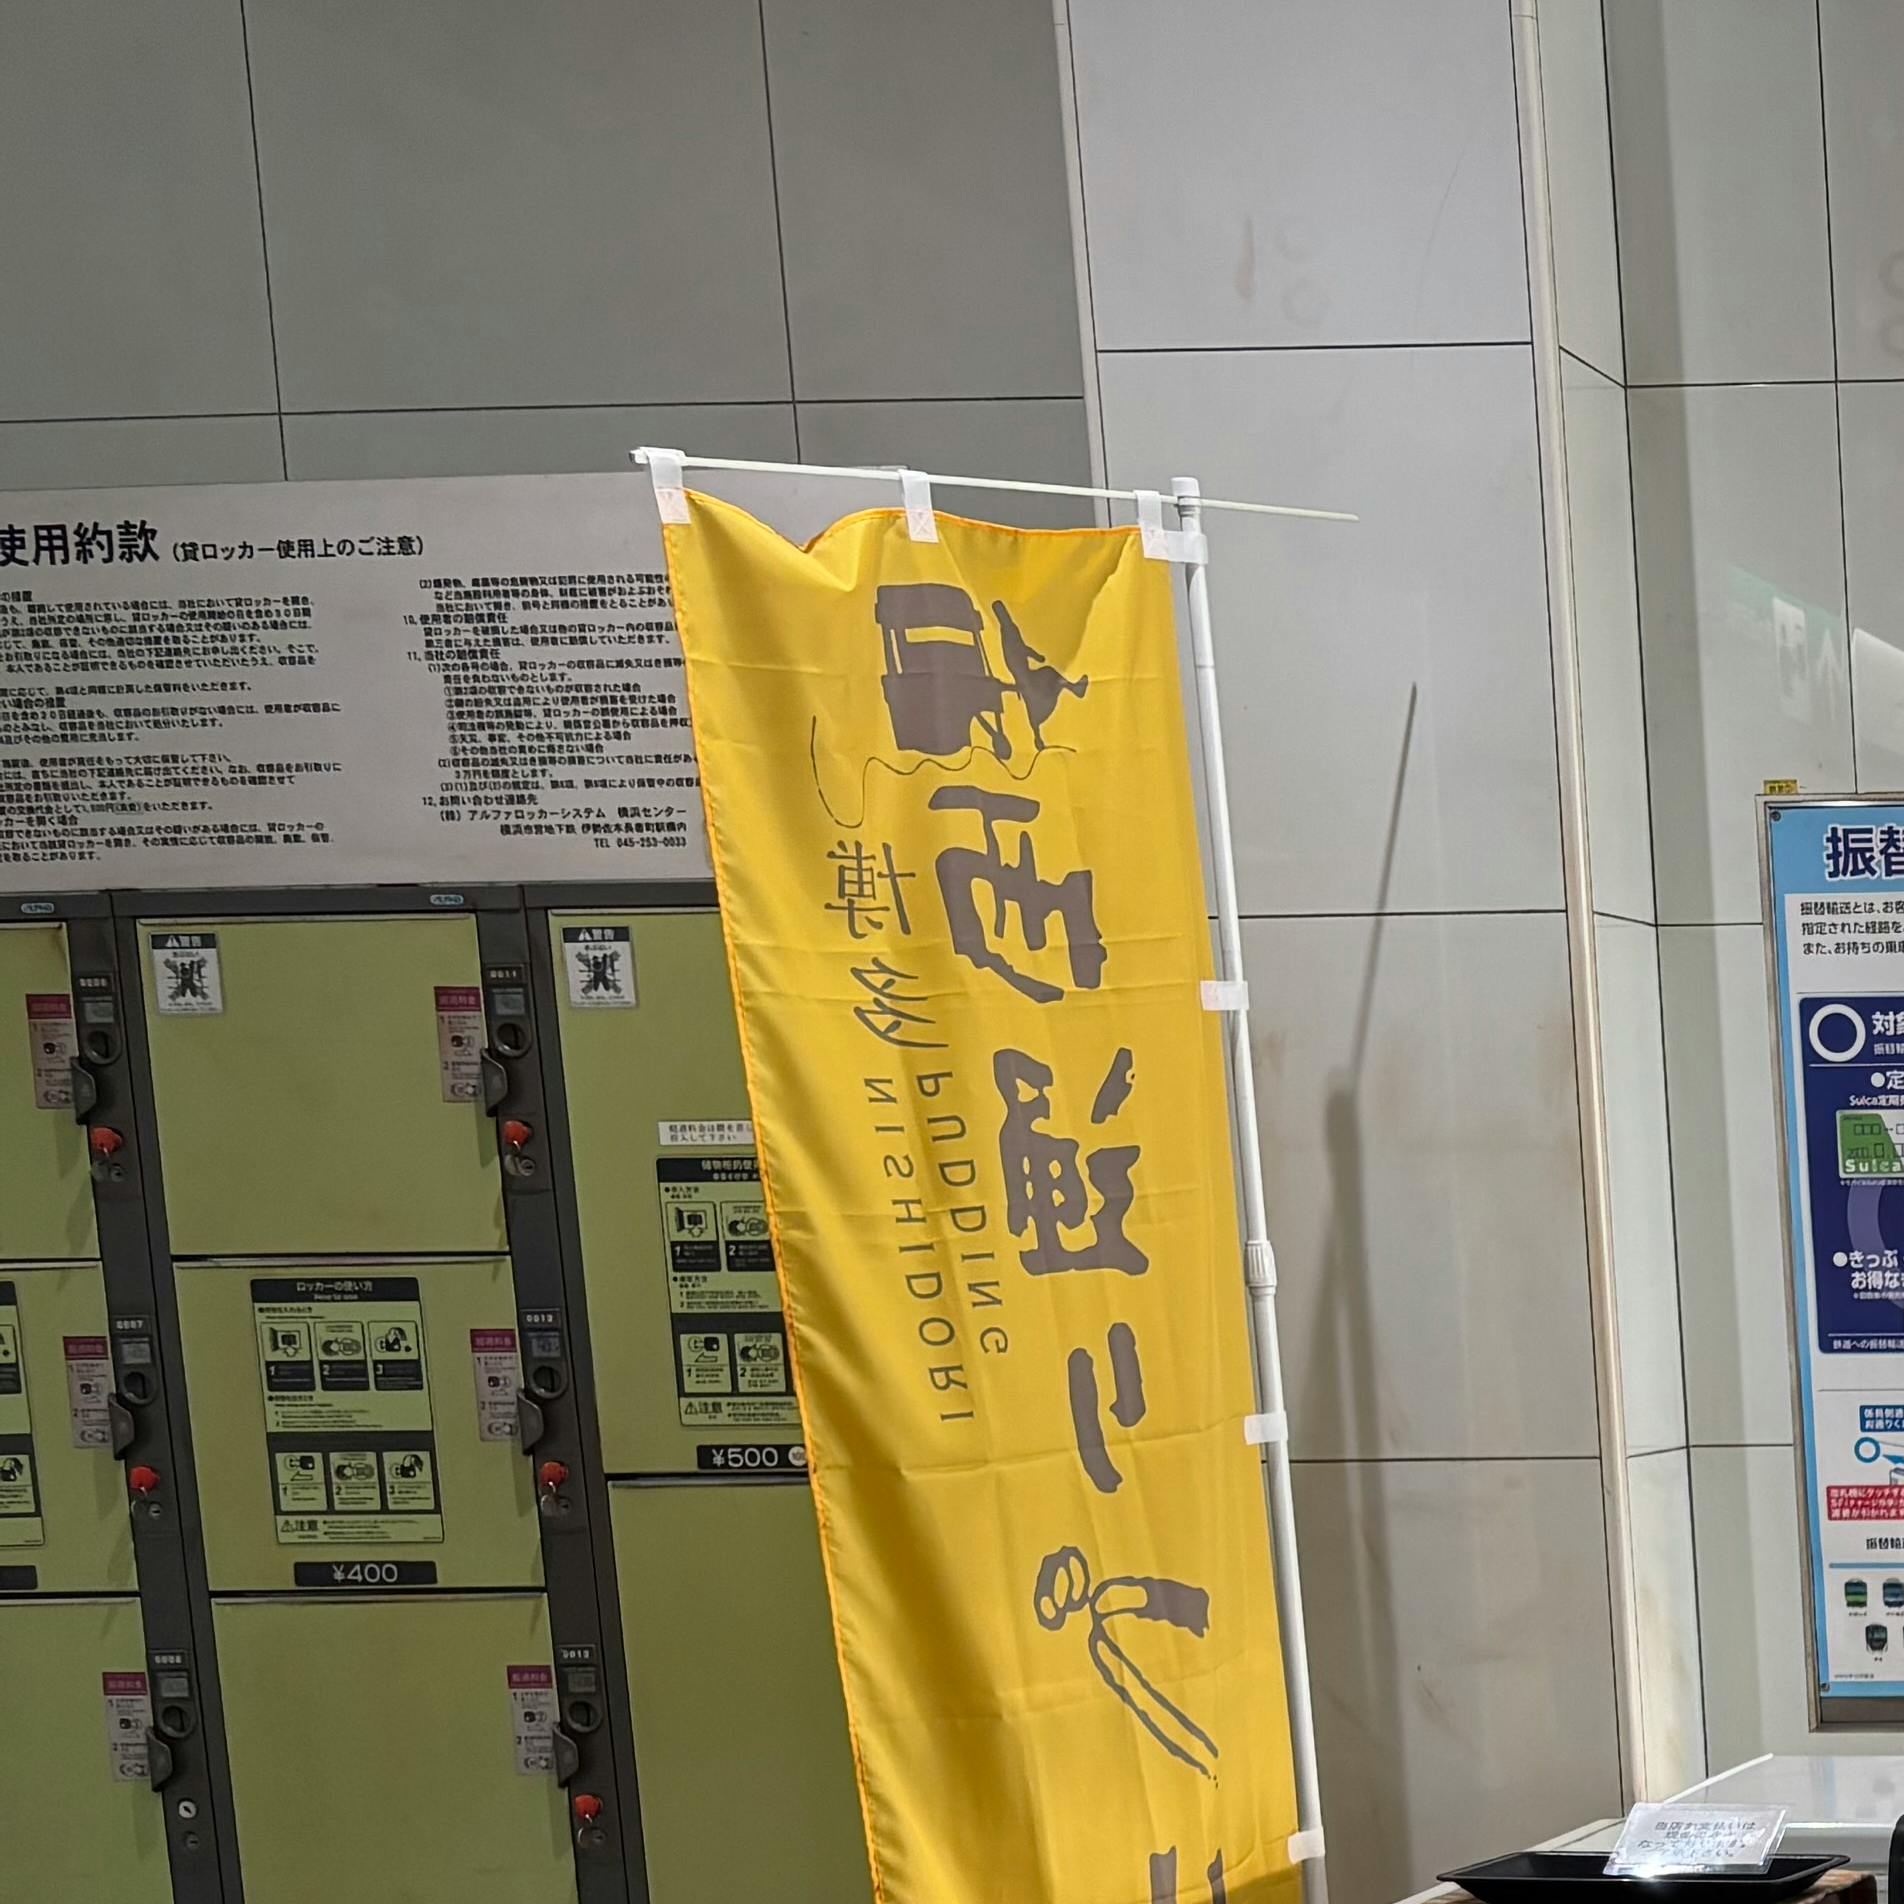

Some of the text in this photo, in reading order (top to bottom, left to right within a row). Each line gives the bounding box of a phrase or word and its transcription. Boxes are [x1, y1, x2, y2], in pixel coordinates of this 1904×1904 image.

[172, 534, 425, 563] (貸ロッカー使用上のご注意)
[711, 1446, 780, 1468] ¥500
[331, 1563, 399, 1584] ¥400
